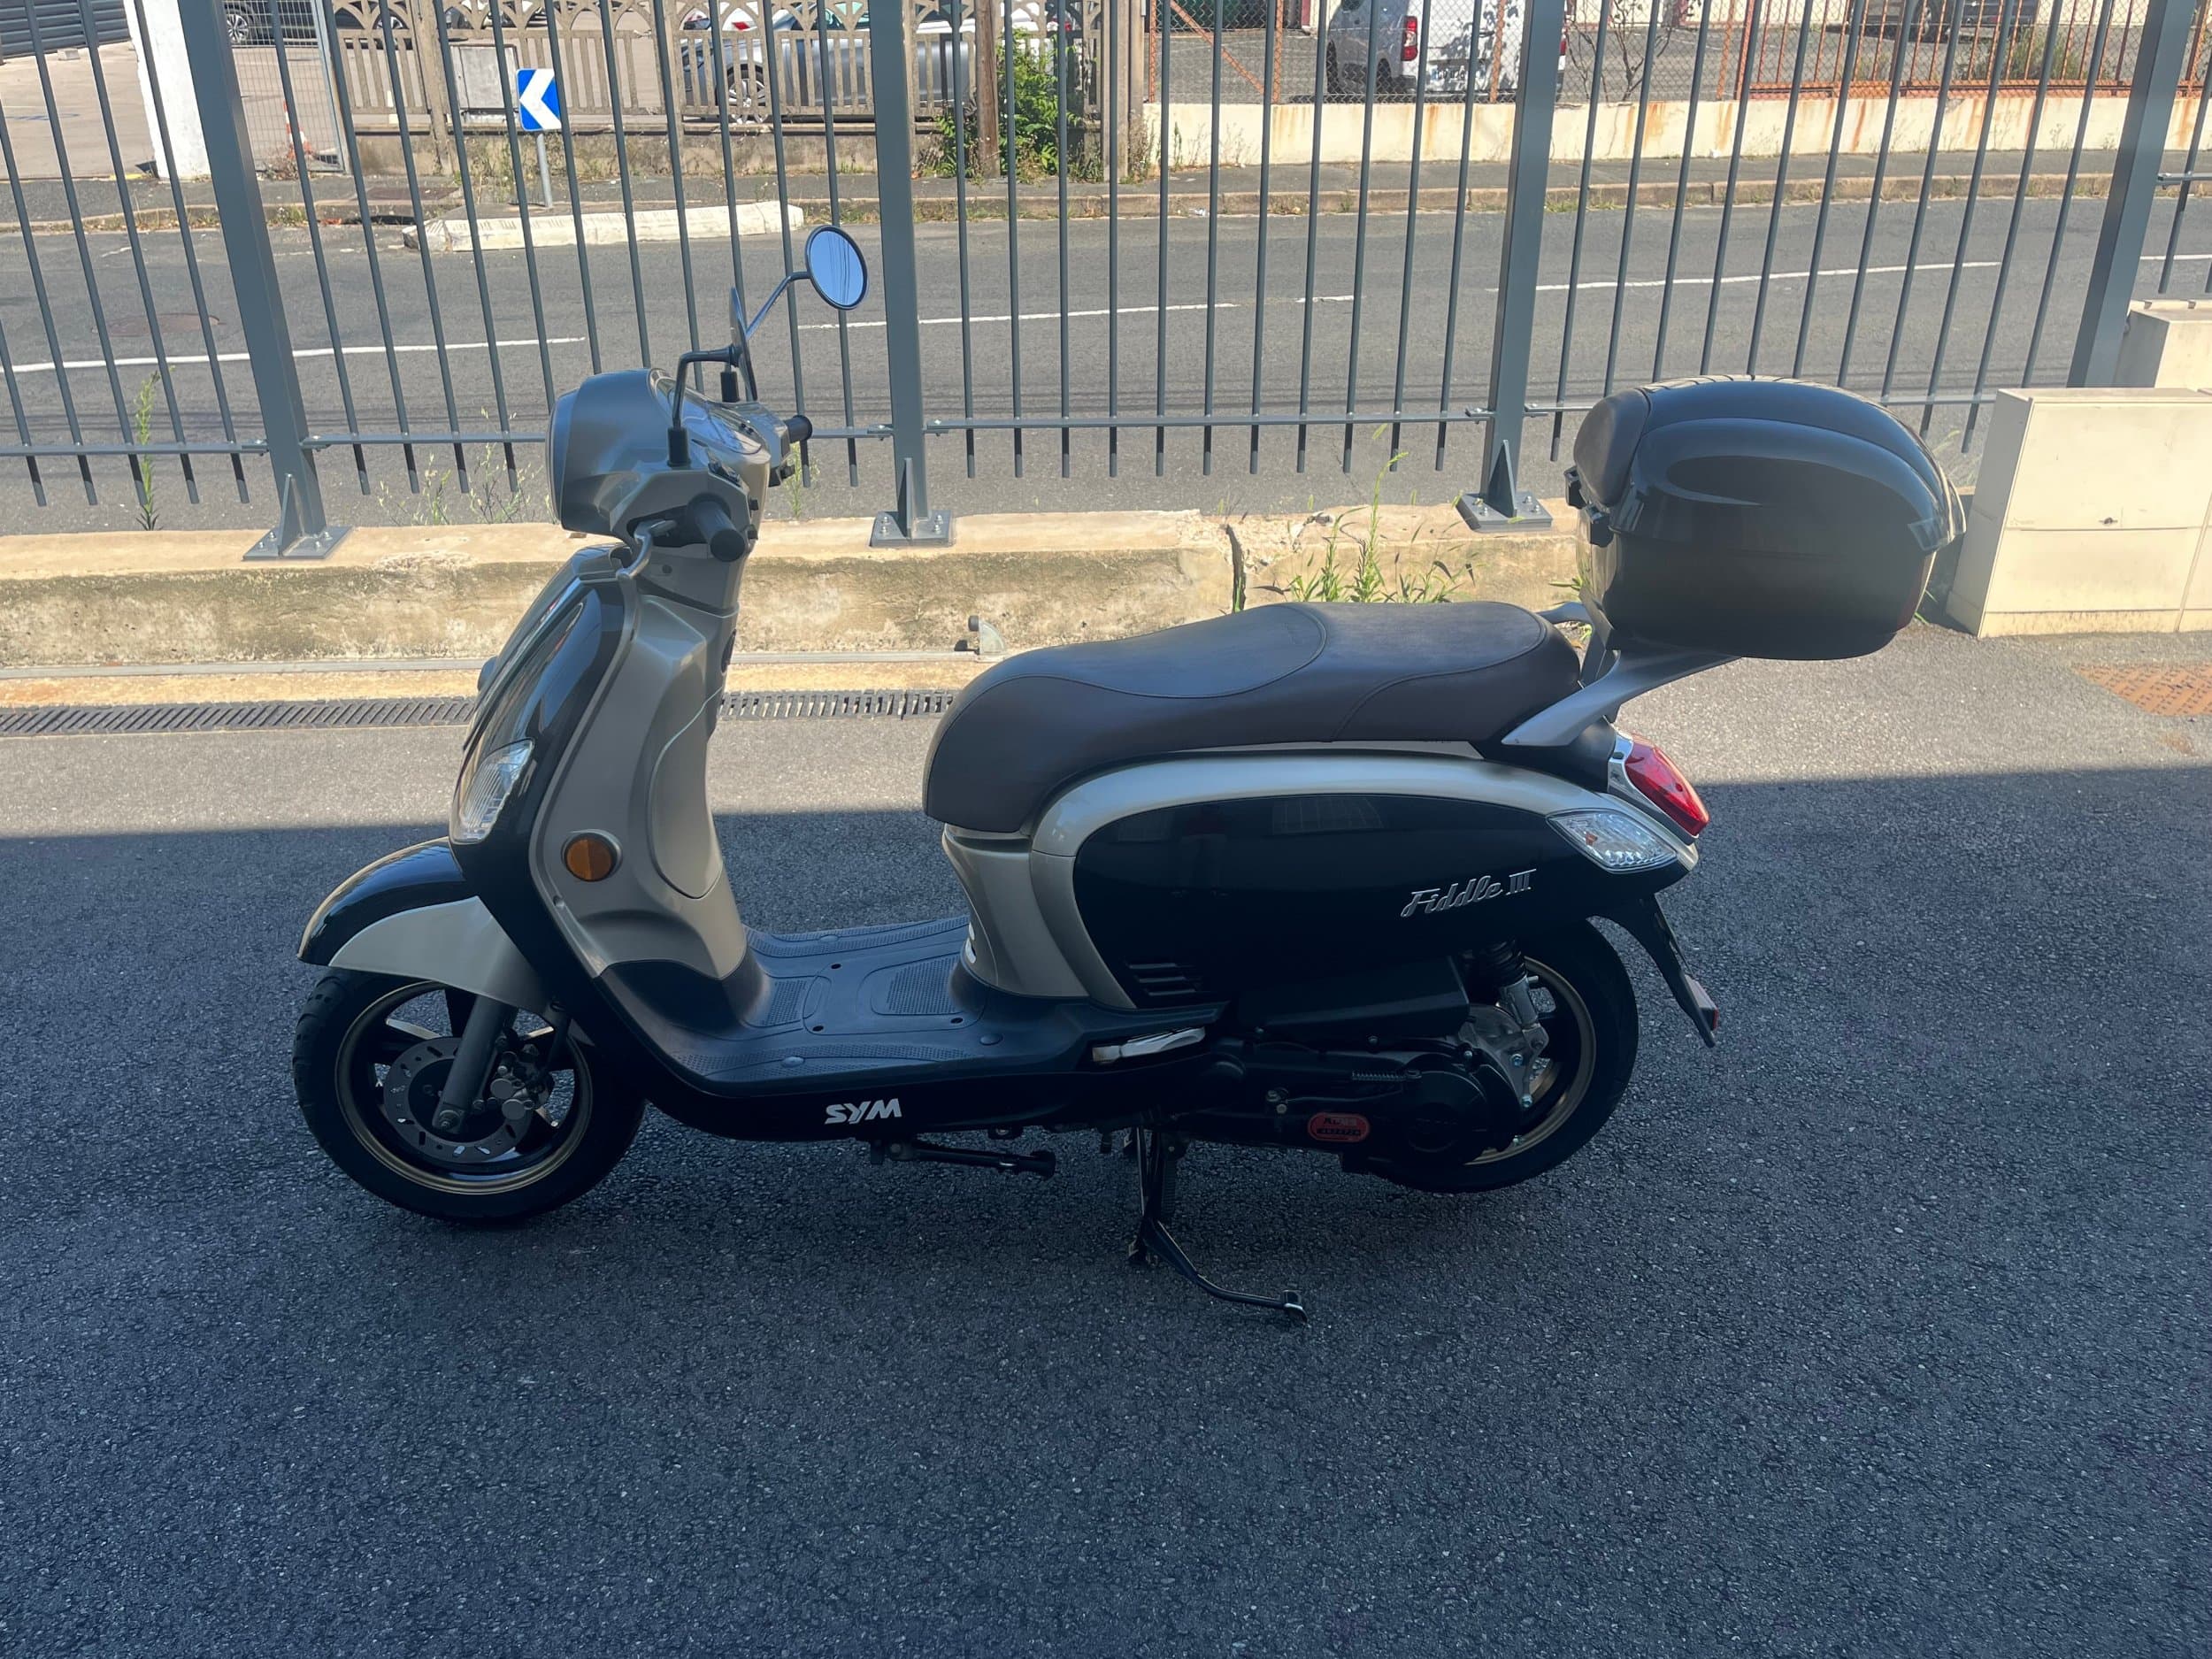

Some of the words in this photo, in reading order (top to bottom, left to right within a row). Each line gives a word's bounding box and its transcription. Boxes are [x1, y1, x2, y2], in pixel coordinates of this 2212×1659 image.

[1400, 875, 1503, 918] Fiddle
[1505, 868, 1537, 895] III
[824, 1098, 902, 1125] SYM
